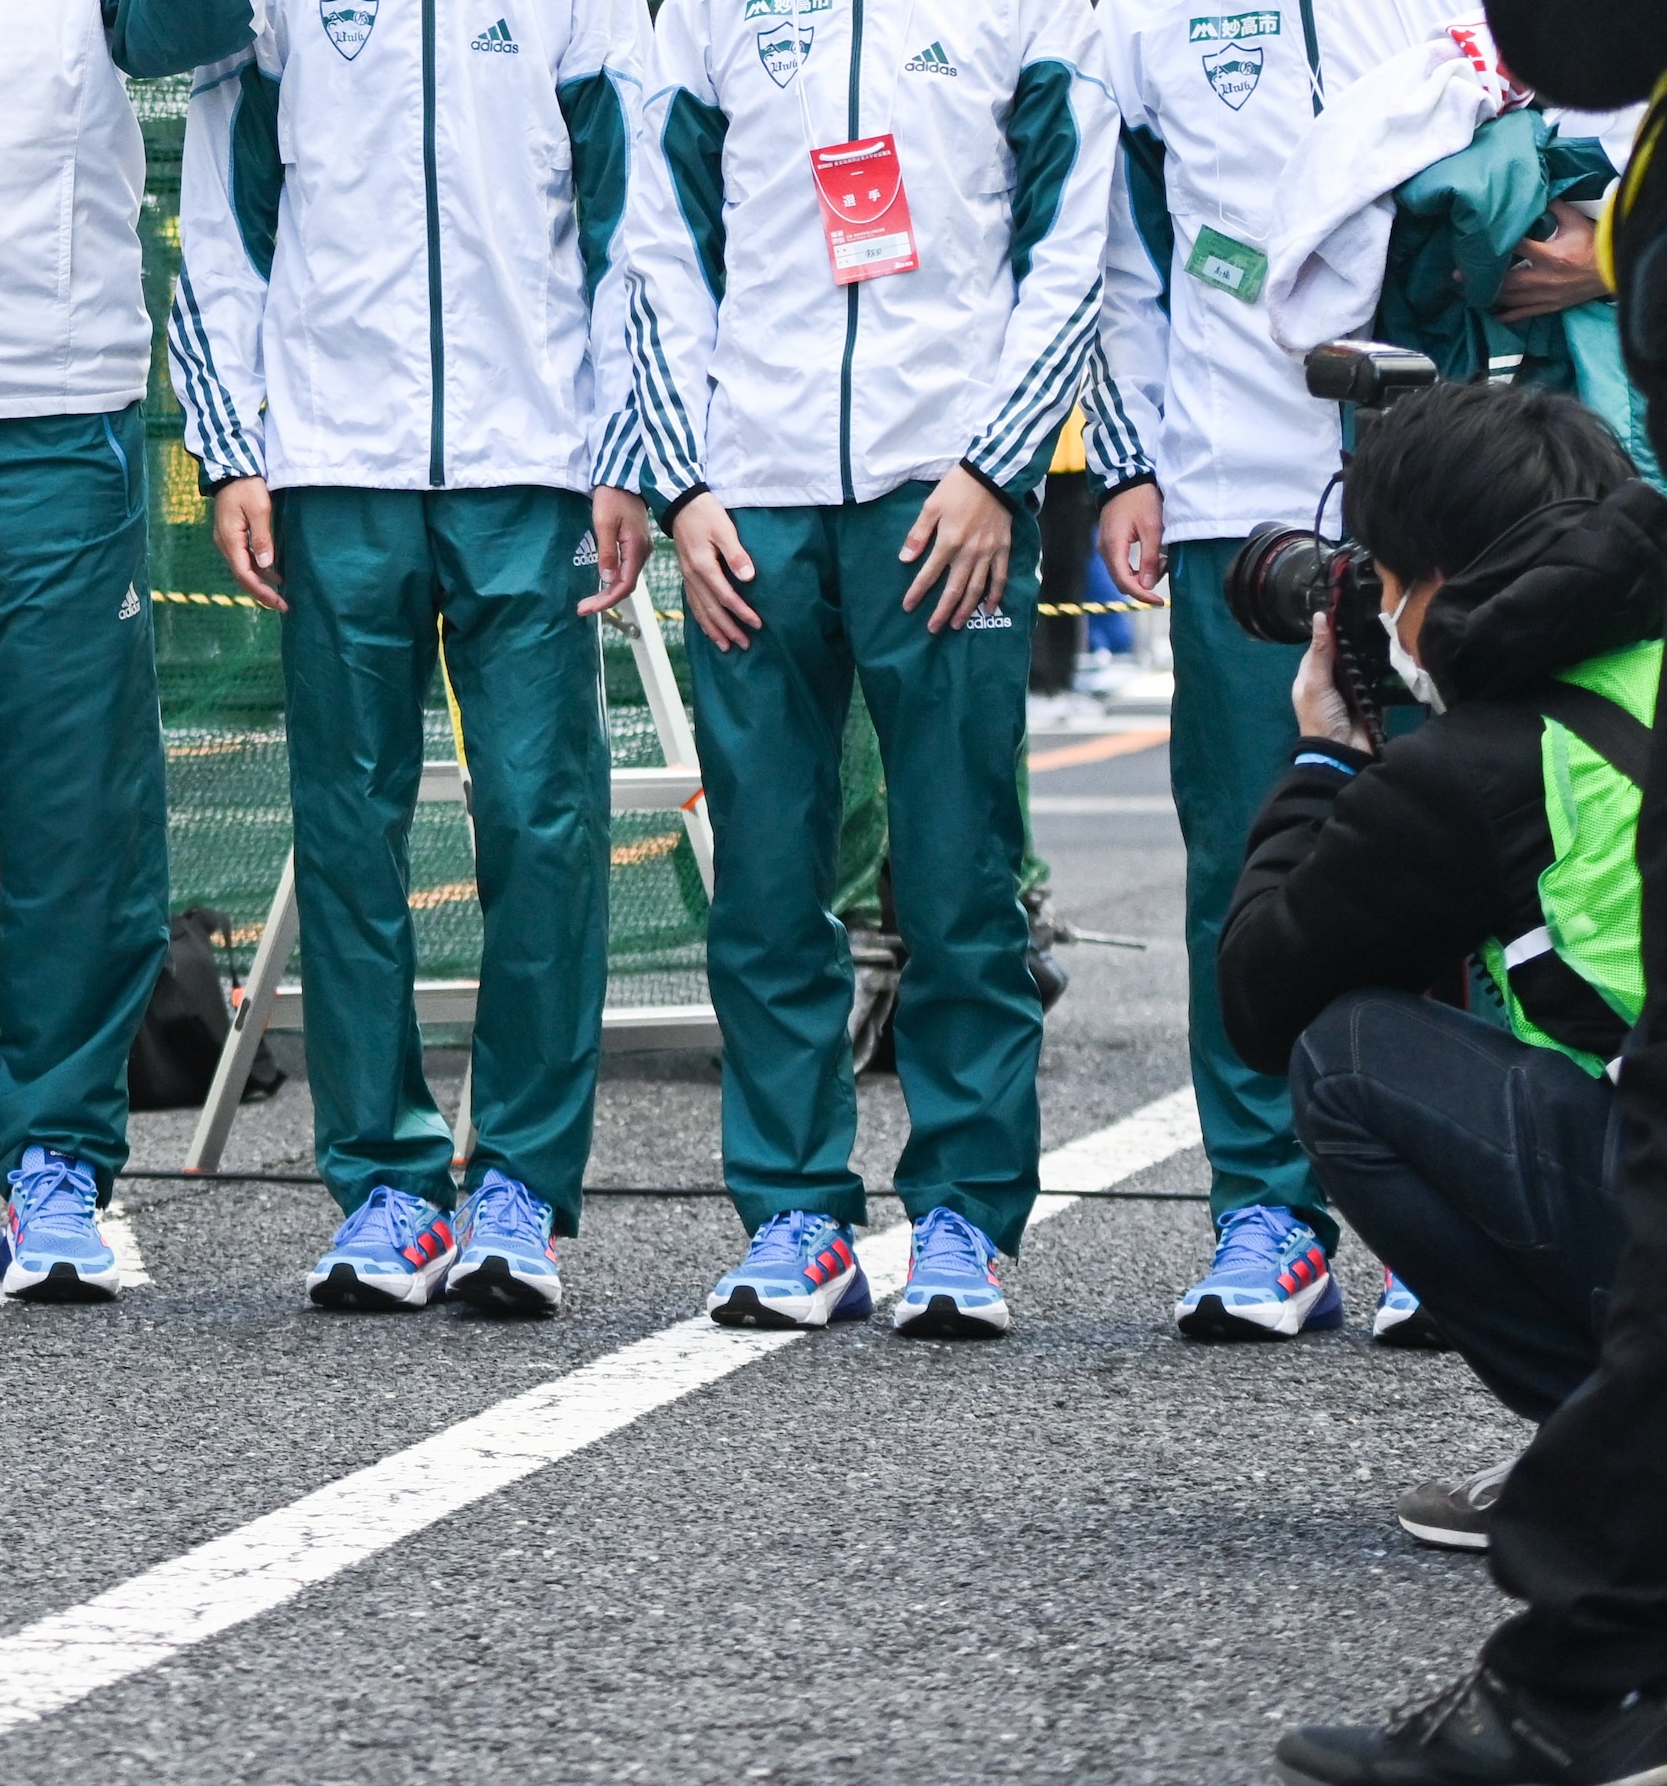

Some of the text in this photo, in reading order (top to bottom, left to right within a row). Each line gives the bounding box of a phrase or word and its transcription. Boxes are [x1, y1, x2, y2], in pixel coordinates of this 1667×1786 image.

[1221, 15, 1278, 38] 妙高市
[471, 39, 519, 54] adidas
[905, 62, 957, 77] adidas
[967, 616, 1012, 630] adidas
